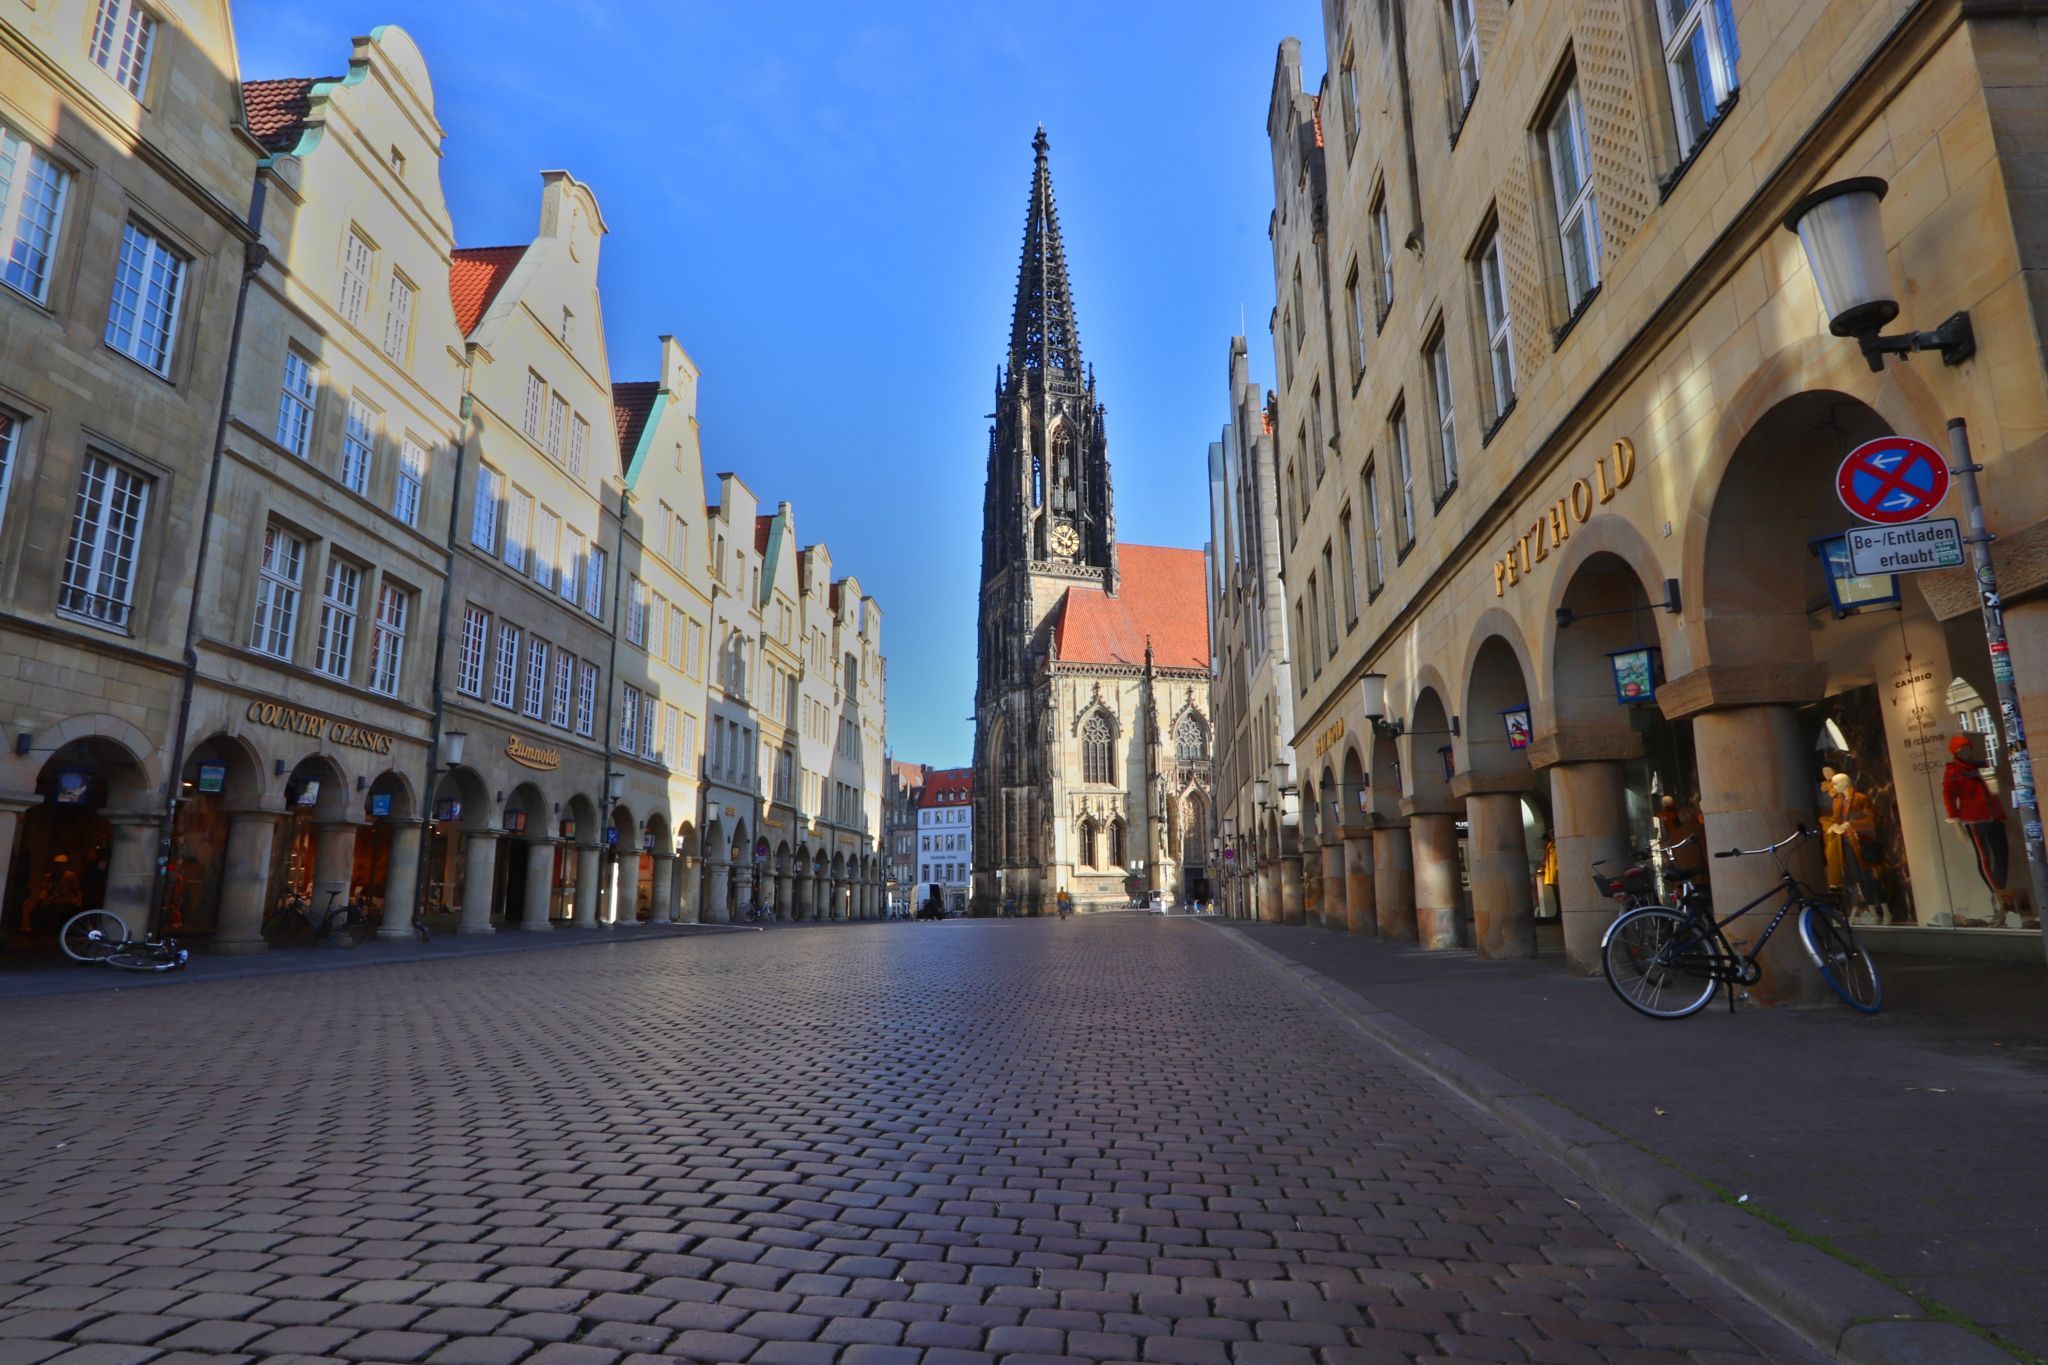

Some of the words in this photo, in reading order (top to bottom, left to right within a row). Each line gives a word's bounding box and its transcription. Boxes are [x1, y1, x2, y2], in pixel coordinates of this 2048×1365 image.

[1494, 437, 1635, 598] PETZHOLD
[1854, 527, 1954, 549] Be-/Entladen
[1880, 548, 1935, 567] erlaubt
[247, 701, 328, 738] COUNTRY
[330, 722, 393, 755] CLASSICS
